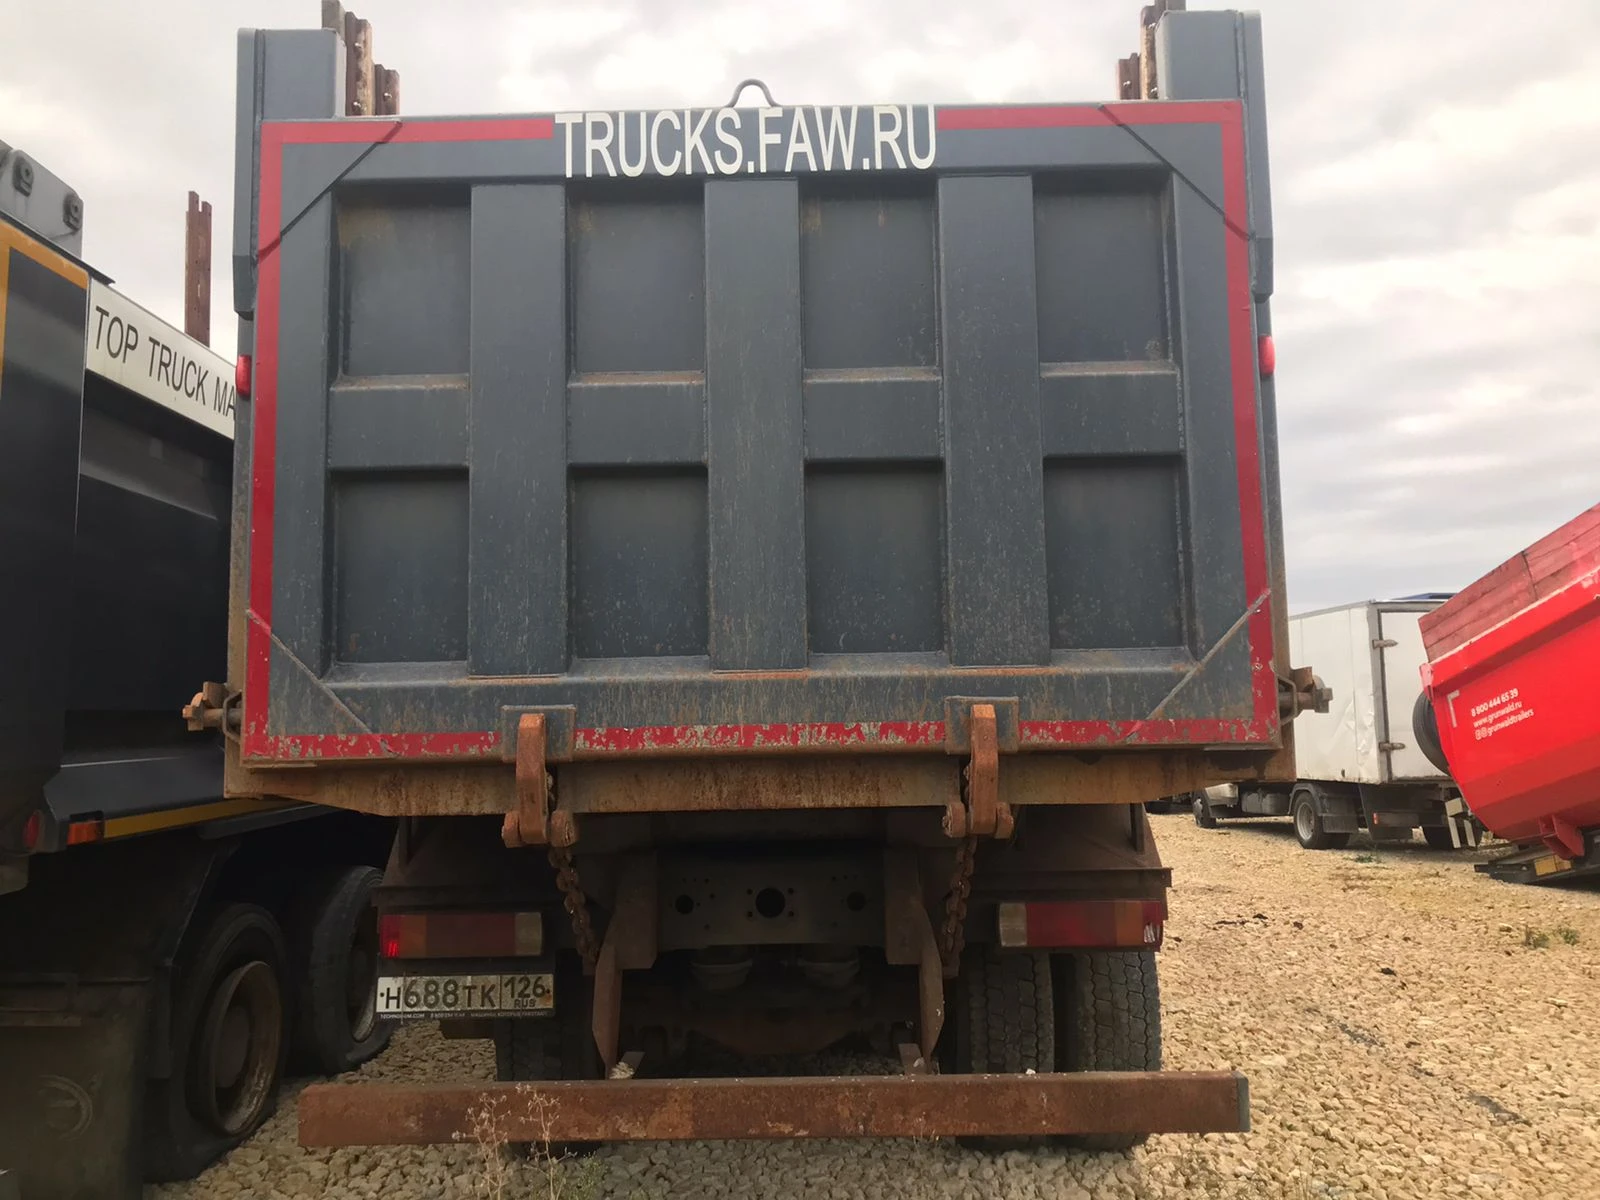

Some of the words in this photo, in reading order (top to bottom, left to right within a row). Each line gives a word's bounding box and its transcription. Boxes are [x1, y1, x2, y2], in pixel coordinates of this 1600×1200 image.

[555, 104, 937, 178] TRUCKS.FAW.RU
[95, 305, 139, 364] TOP
[148, 336, 209, 406] TRUCK
[504, 976, 545, 998] 126
[514, 999, 536, 1009] RUS
